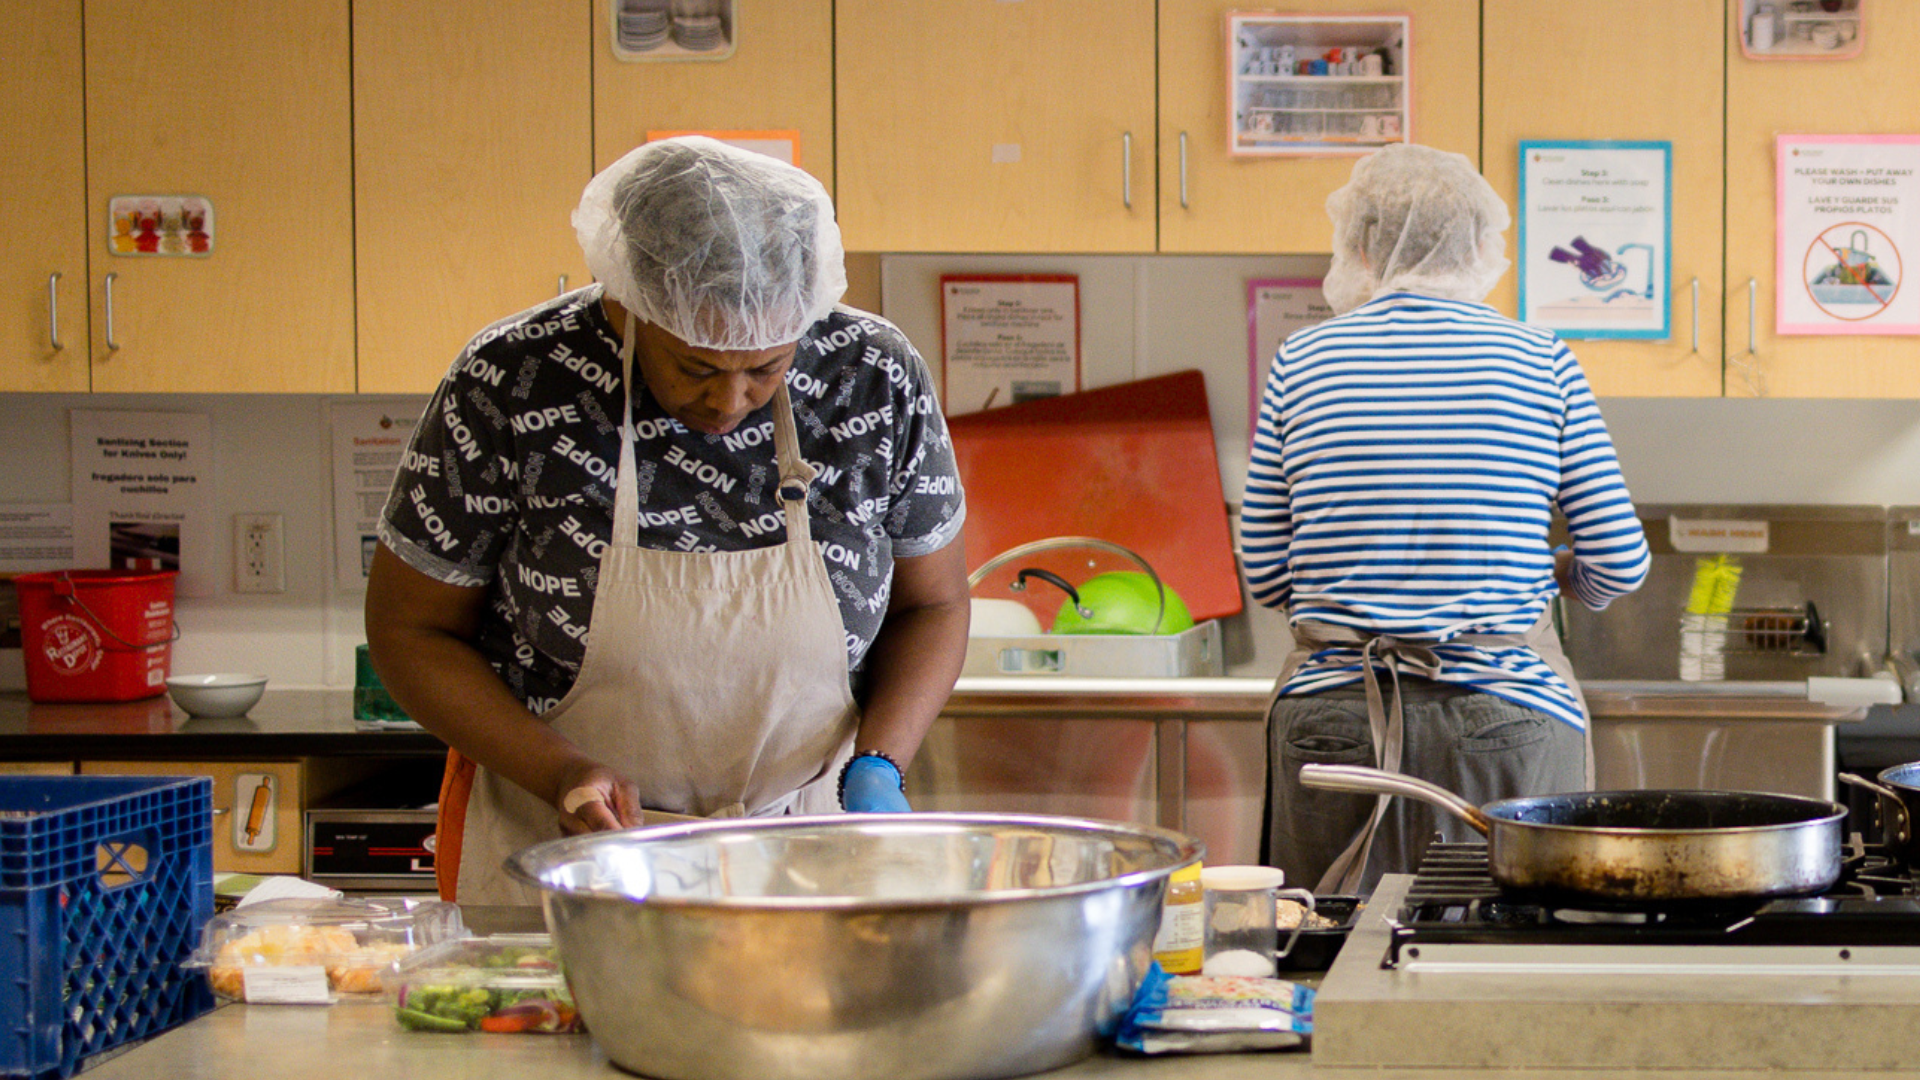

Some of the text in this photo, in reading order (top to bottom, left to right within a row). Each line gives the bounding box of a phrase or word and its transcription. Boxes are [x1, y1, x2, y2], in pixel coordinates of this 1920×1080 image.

[1795, 168, 1828, 176] PLEASE
[1831, 168, 1858, 176] WASH
[1866, 168, 1883, 176] PUT
[1886, 168, 1914, 176] AWAY
[1814, 206, 1893, 214] PROPIOS PLATOS
[506, 313, 580, 342] NOPE
[812, 319, 879, 357] NOPE
[462, 356, 506, 387] NO
[549, 343, 620, 394] NOPE
[861, 345, 914, 397] NOPE
[443, 393, 482, 462] NOPE
[510, 405, 582, 436] NOPE
[829, 404, 894, 444] NOPE
[149, 439, 189, 448] Section
[722, 421, 775, 454] NOP
[103, 449, 118, 458] for
[121, 450, 157, 459] Knives
[551, 434, 617, 489] NOPE
[663, 445, 738, 494] NOPE
[913, 475, 955, 496] NOPE
[410, 484, 459, 552] NOPE
[637, 505, 704, 529] NOPE
[739, 509, 787, 539] NOP
[845, 495, 891, 527] NPE
[558, 515, 612, 560] OPE
[820, 540, 861, 572] NO
[518, 562, 582, 598] NOPE
[547, 604, 590, 648] PE
